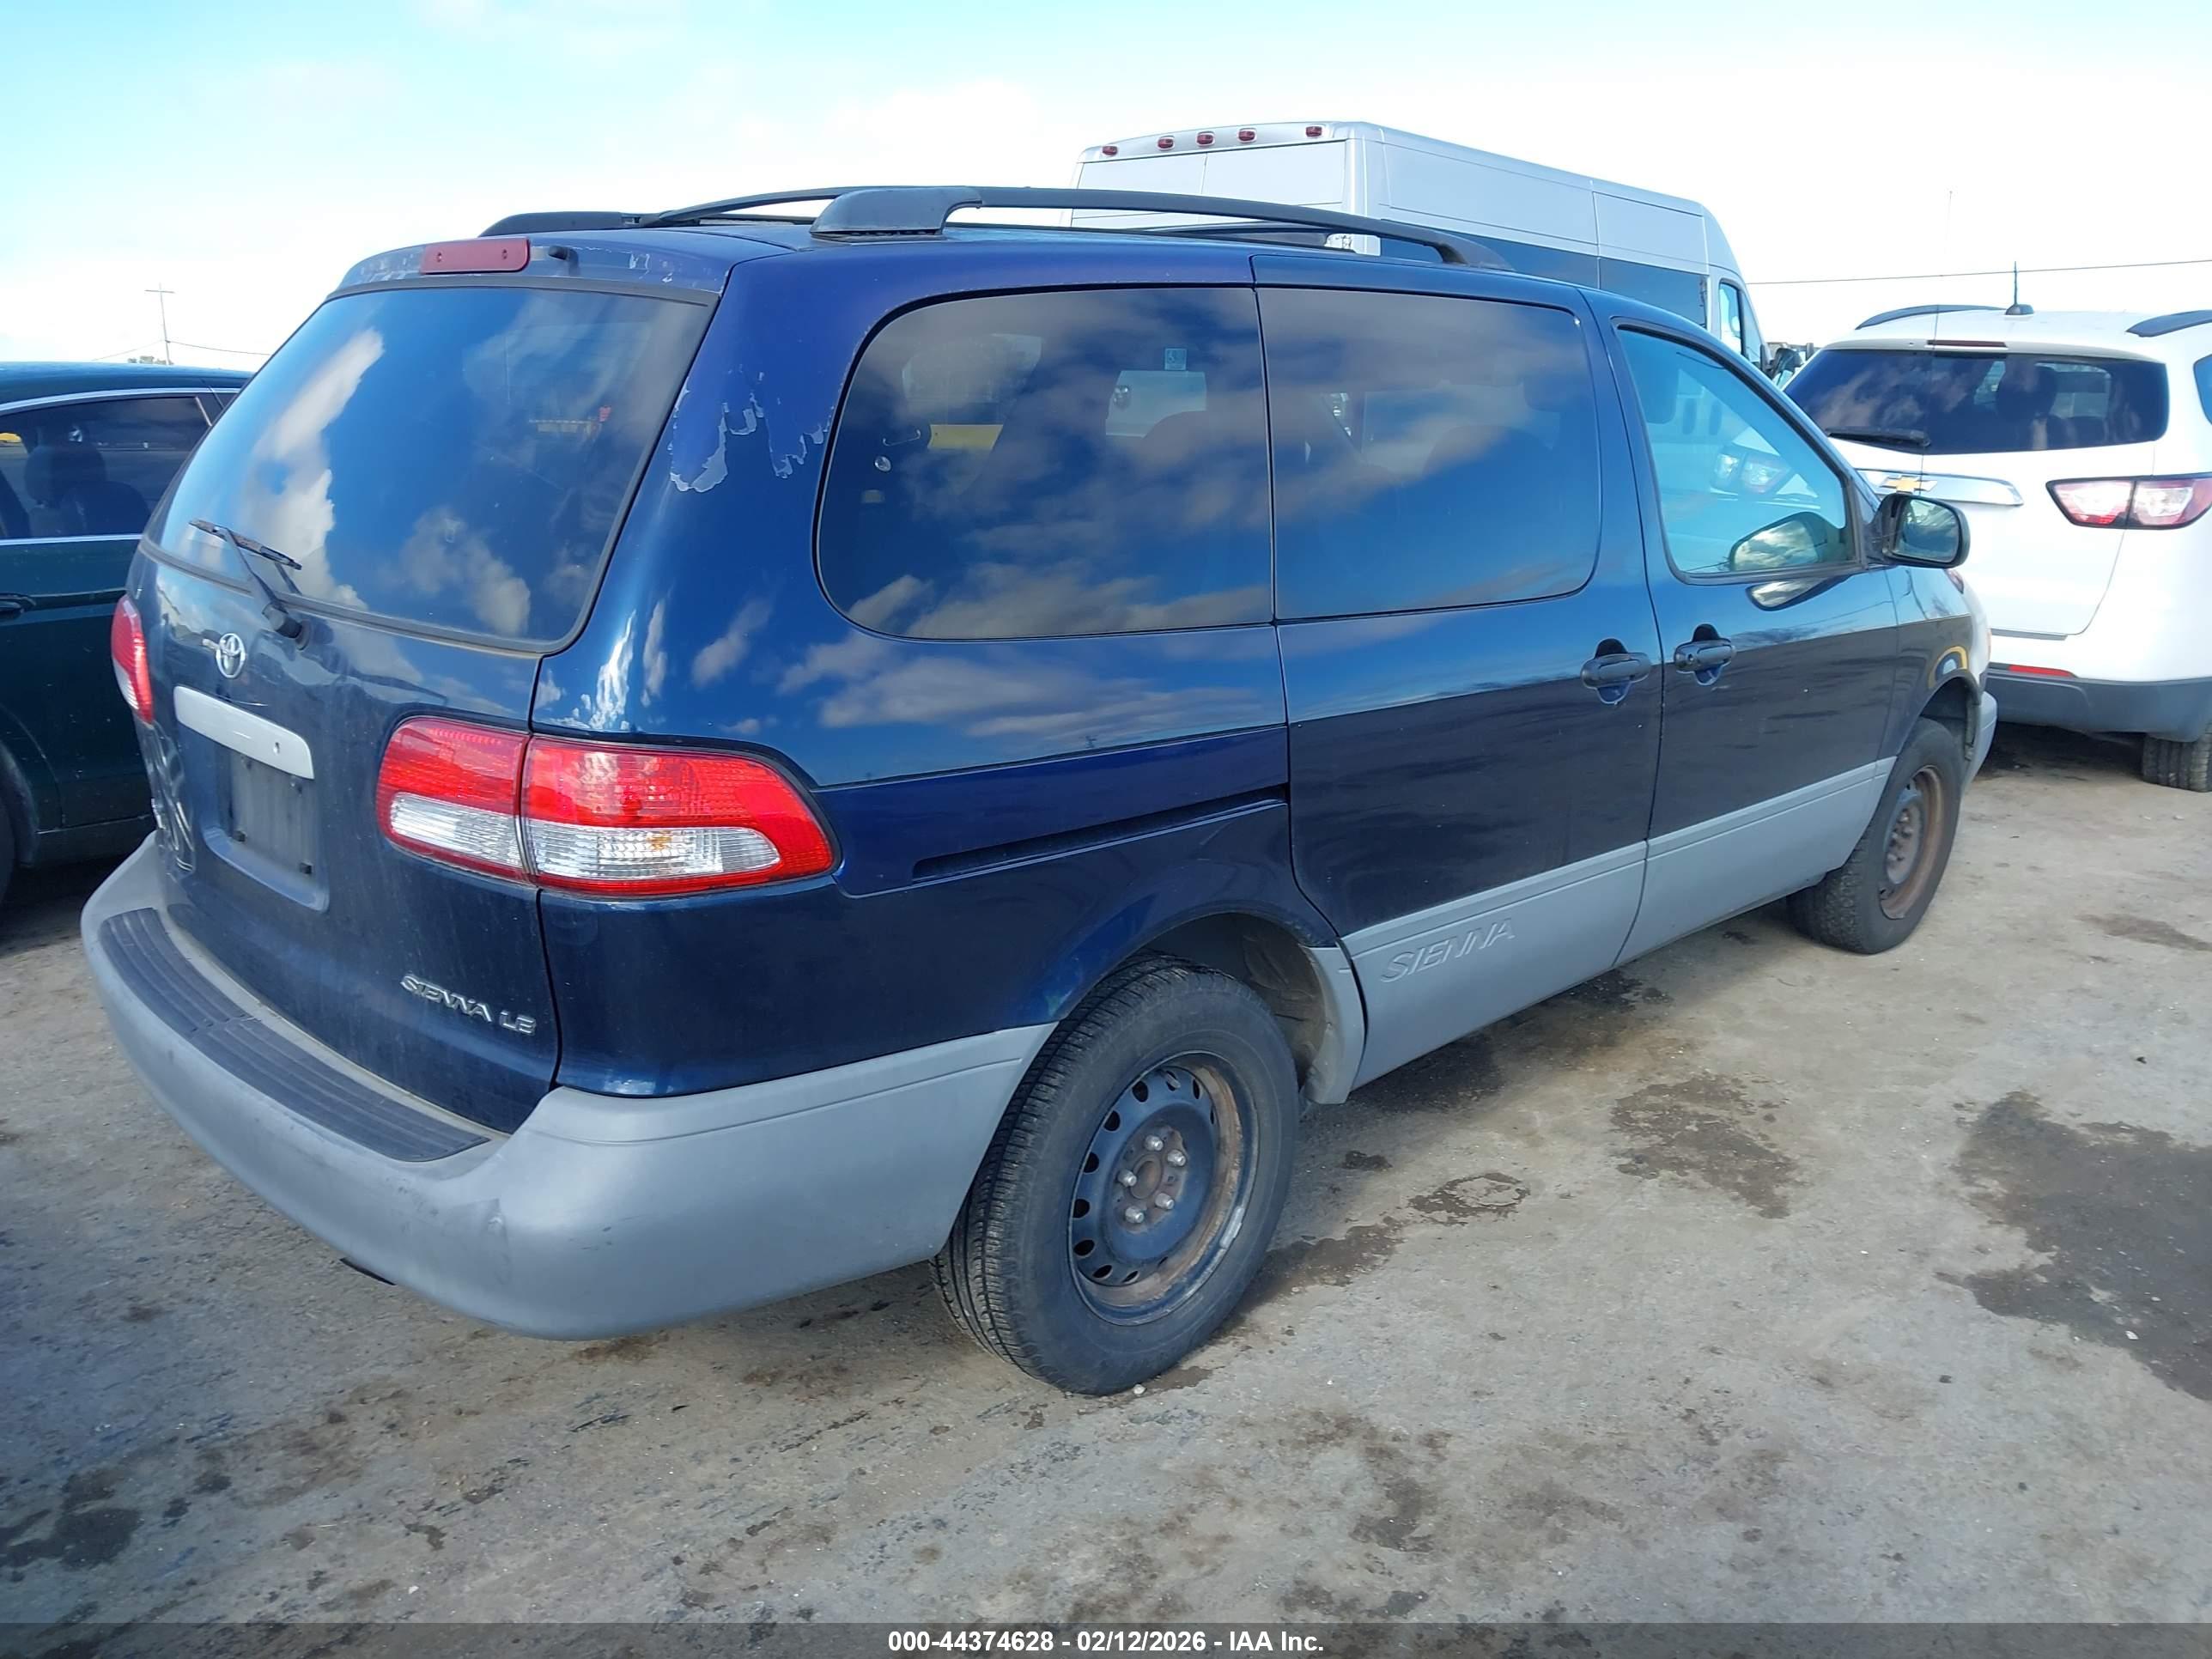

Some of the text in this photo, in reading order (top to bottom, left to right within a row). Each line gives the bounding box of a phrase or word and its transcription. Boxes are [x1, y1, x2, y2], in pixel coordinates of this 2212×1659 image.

[1380, 917, 1516, 983] SIENNA
[400, 973, 537, 1036] SIENNA LE
